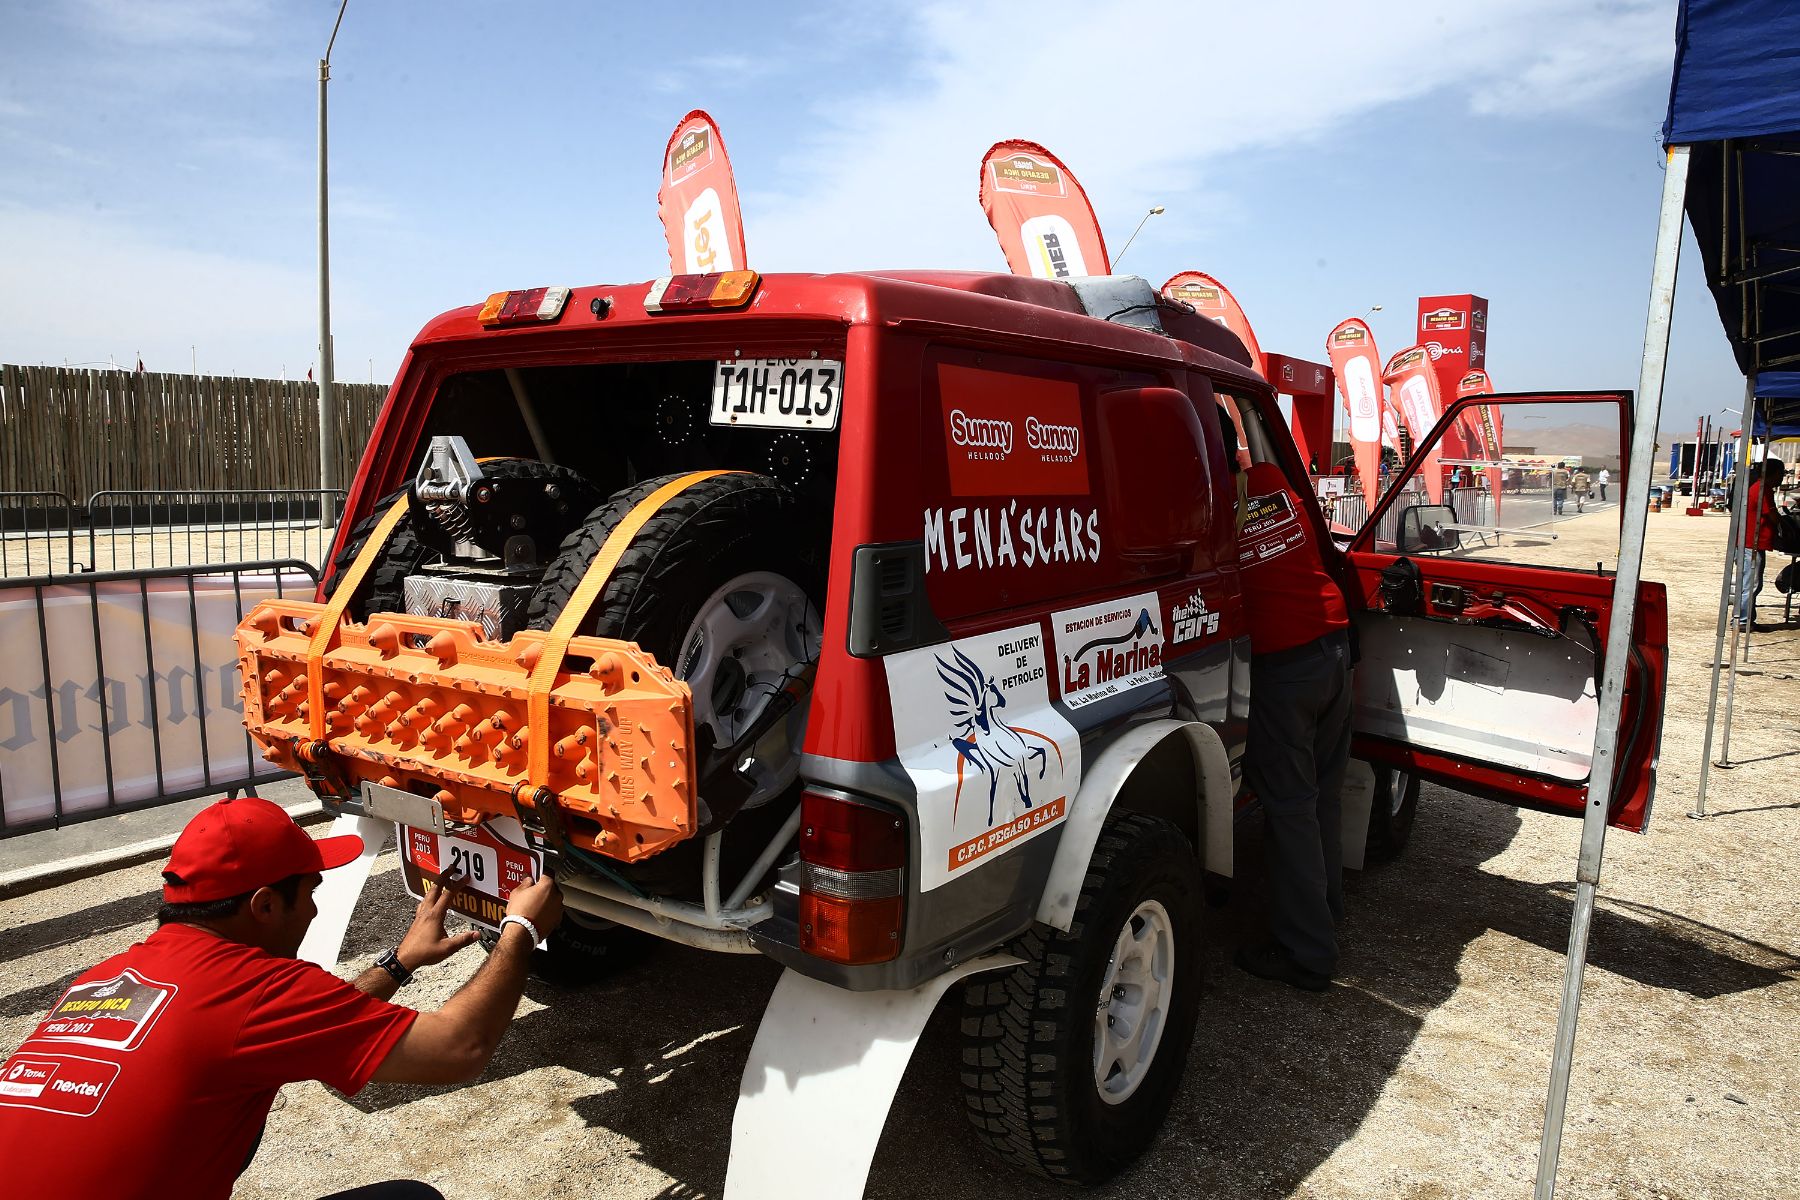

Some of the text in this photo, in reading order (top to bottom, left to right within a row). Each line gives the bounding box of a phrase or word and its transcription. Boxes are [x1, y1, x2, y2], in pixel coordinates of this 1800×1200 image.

[720, 367, 836, 416] T1H-013
[950, 409, 1079, 457] Sunny Sunny
[967, 451, 1073, 463] HELADOS HELADOS
[1259, 503, 1278, 514] INCA
[1065, 608, 1132, 634] ESTACION DE SERVICIOS
[1172, 605, 1187, 622] the
[1173, 612, 1220, 644] cars
[997, 635, 1040, 658] DELIVERY
[1016, 656, 1028, 669] DE
[1064, 641, 1163, 694] La Marina
[1002, 667, 1044, 690] PETROLEO
[620, 739, 634, 770] WAY
[621, 775, 635, 806] THIS
[414, 832, 431, 842] PERÚ
[957, 804, 1059, 862] C.P.C. PEGASO S.A.C.
[415, 842, 431, 855] 2013
[451, 846, 485, 881] 219
[505, 860, 524, 872] PERÚ
[482, 900, 507, 922] INC
[58, 998, 132, 1013] DESAFIO INCA
[67, 1022, 95, 1034] 2013
[51, 1079, 103, 1097] nextel
